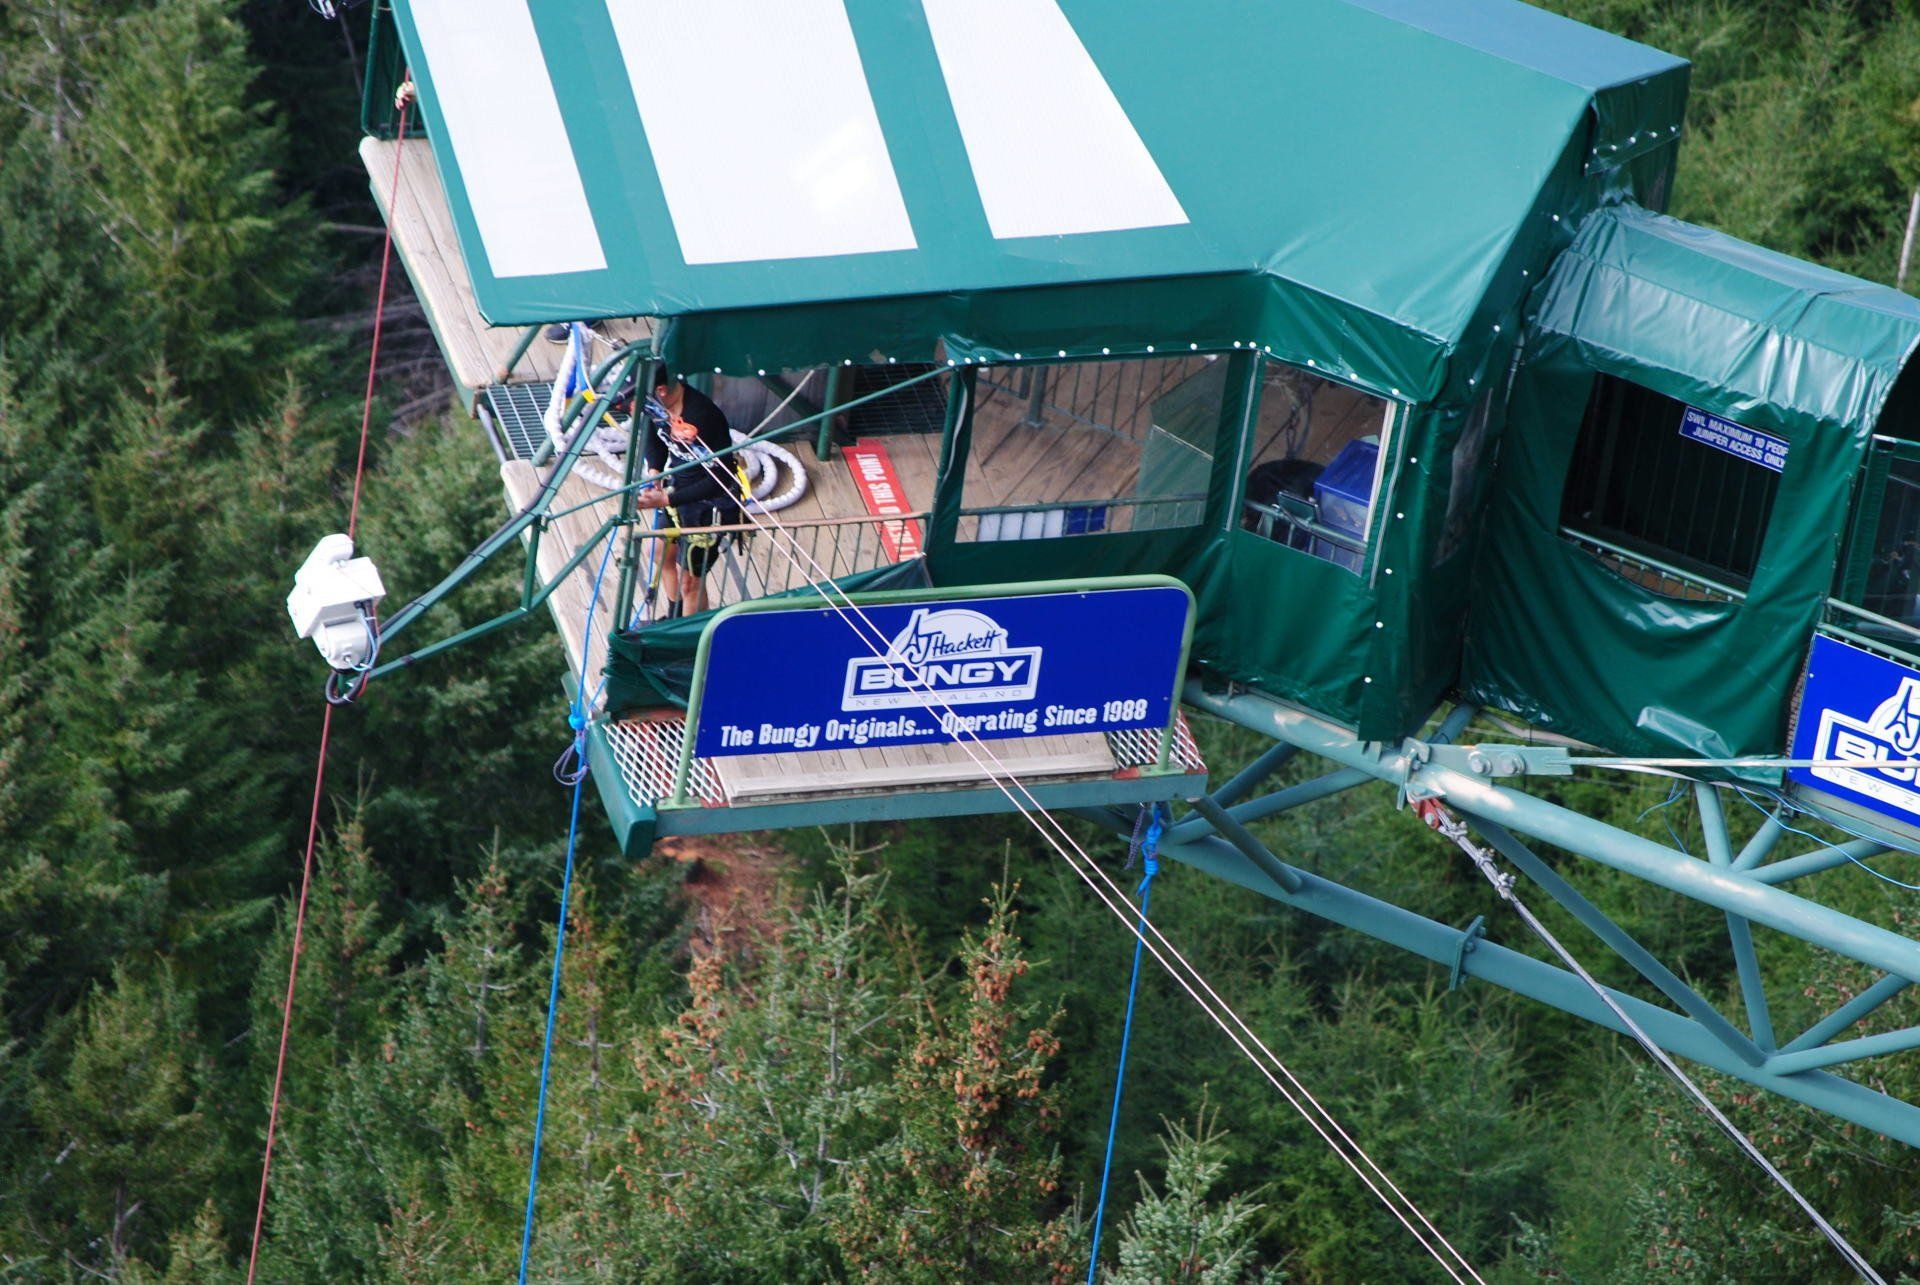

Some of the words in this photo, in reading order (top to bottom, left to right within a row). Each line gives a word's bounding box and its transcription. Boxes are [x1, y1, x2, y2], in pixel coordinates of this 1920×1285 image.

[1693, 427, 1729, 447] JUMPER
[1728, 441, 1764, 460] ACCESS
[1708, 419, 1753, 444] MAXIMUM
[855, 453, 888, 482] POINT
[868, 482, 897, 505] THIS
[878, 506, 915, 544] BEYOD
[860, 659, 1026, 691] BUNGY
[855, 697, 901, 707] NEW
[721, 725, 754, 748] The
[758, 723, 821, 748] Bungy
[825, 715, 935, 744] Originals...
[940, 708, 1039, 737] Operating
[1043, 705, 1098, 727] Since
[1103, 698, 1149, 722] 1988
